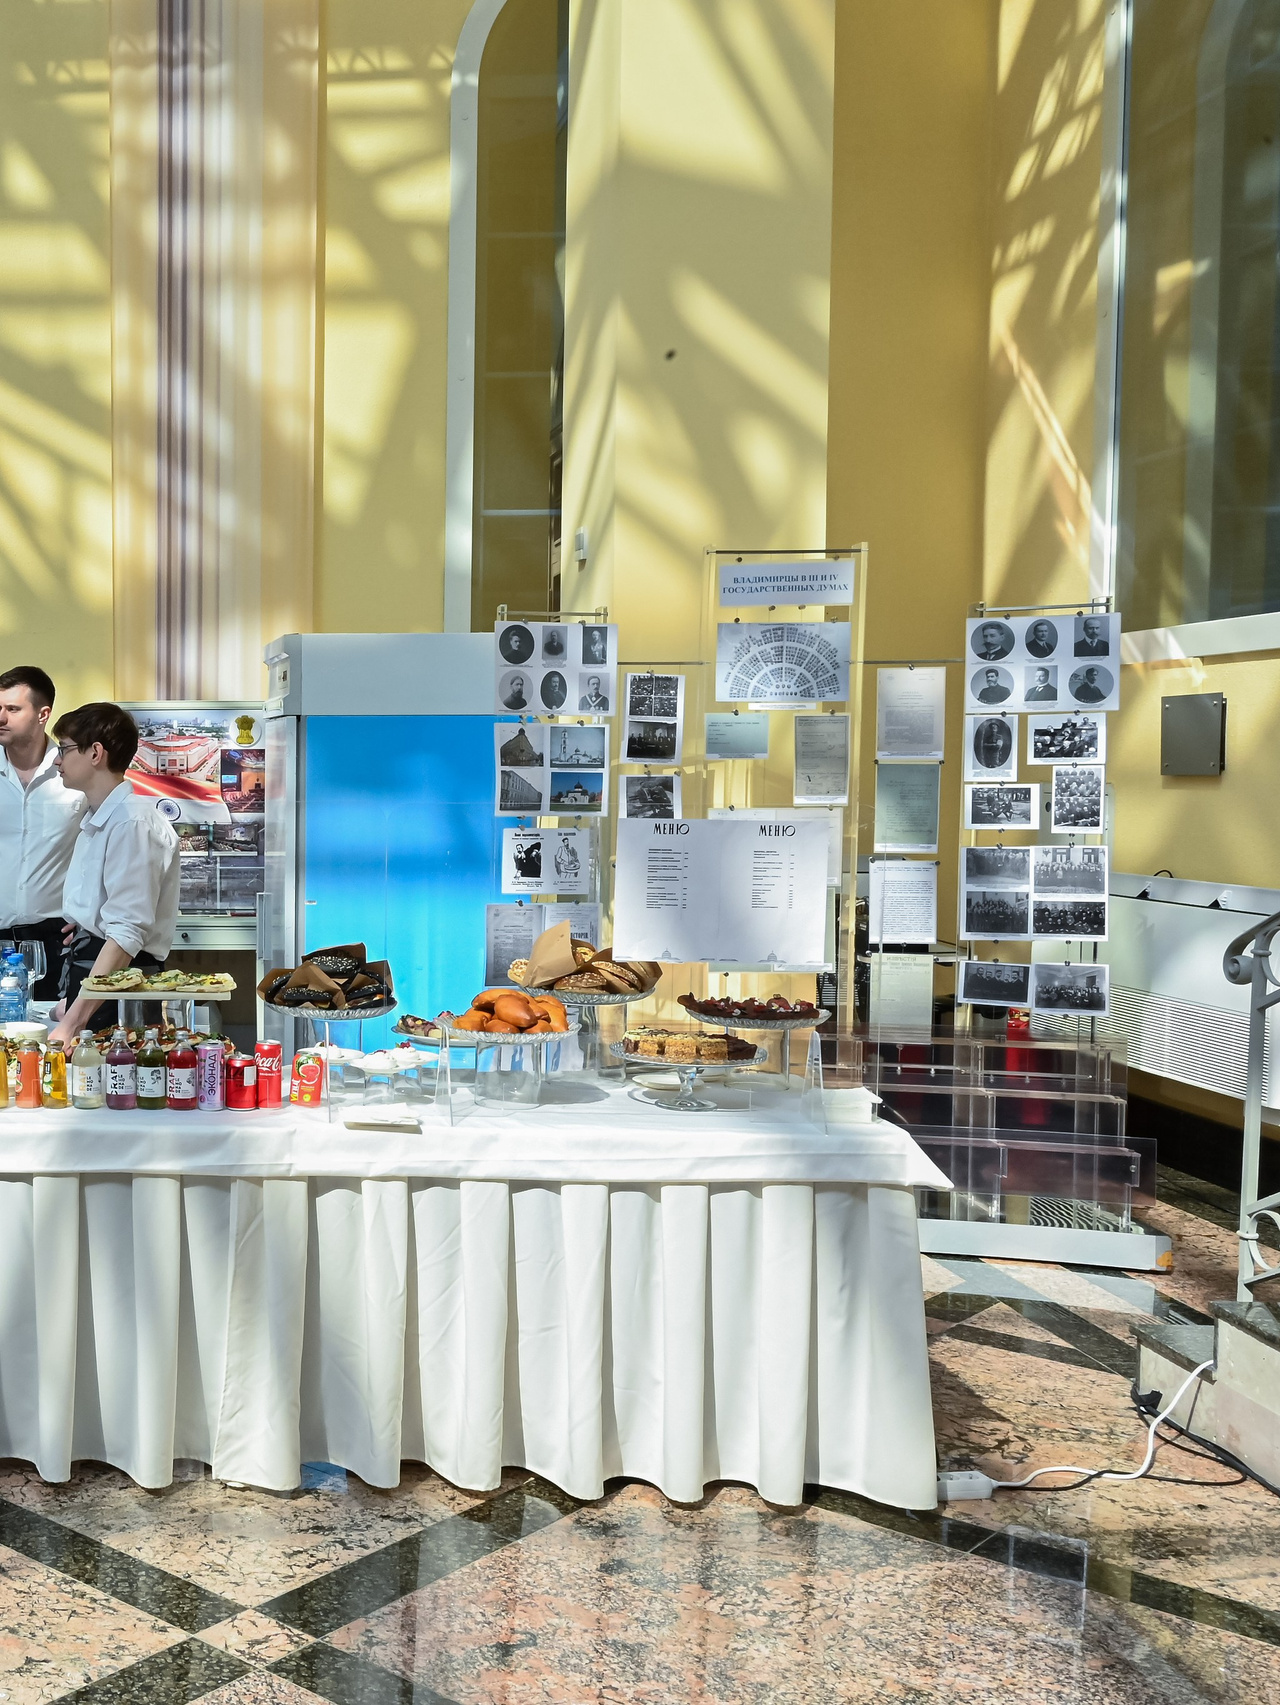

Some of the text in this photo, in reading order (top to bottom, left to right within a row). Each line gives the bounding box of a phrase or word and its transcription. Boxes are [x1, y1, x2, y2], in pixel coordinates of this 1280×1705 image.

[733, 575, 799, 583] ВЛАДИМИРЦЫ
[722, 583, 849, 594] ГОСУДАРСТВЕННЫХ ДУМАХ
[653, 823, 690, 835] МЕНЮ
[758, 825, 796, 837] МЕНЮ
